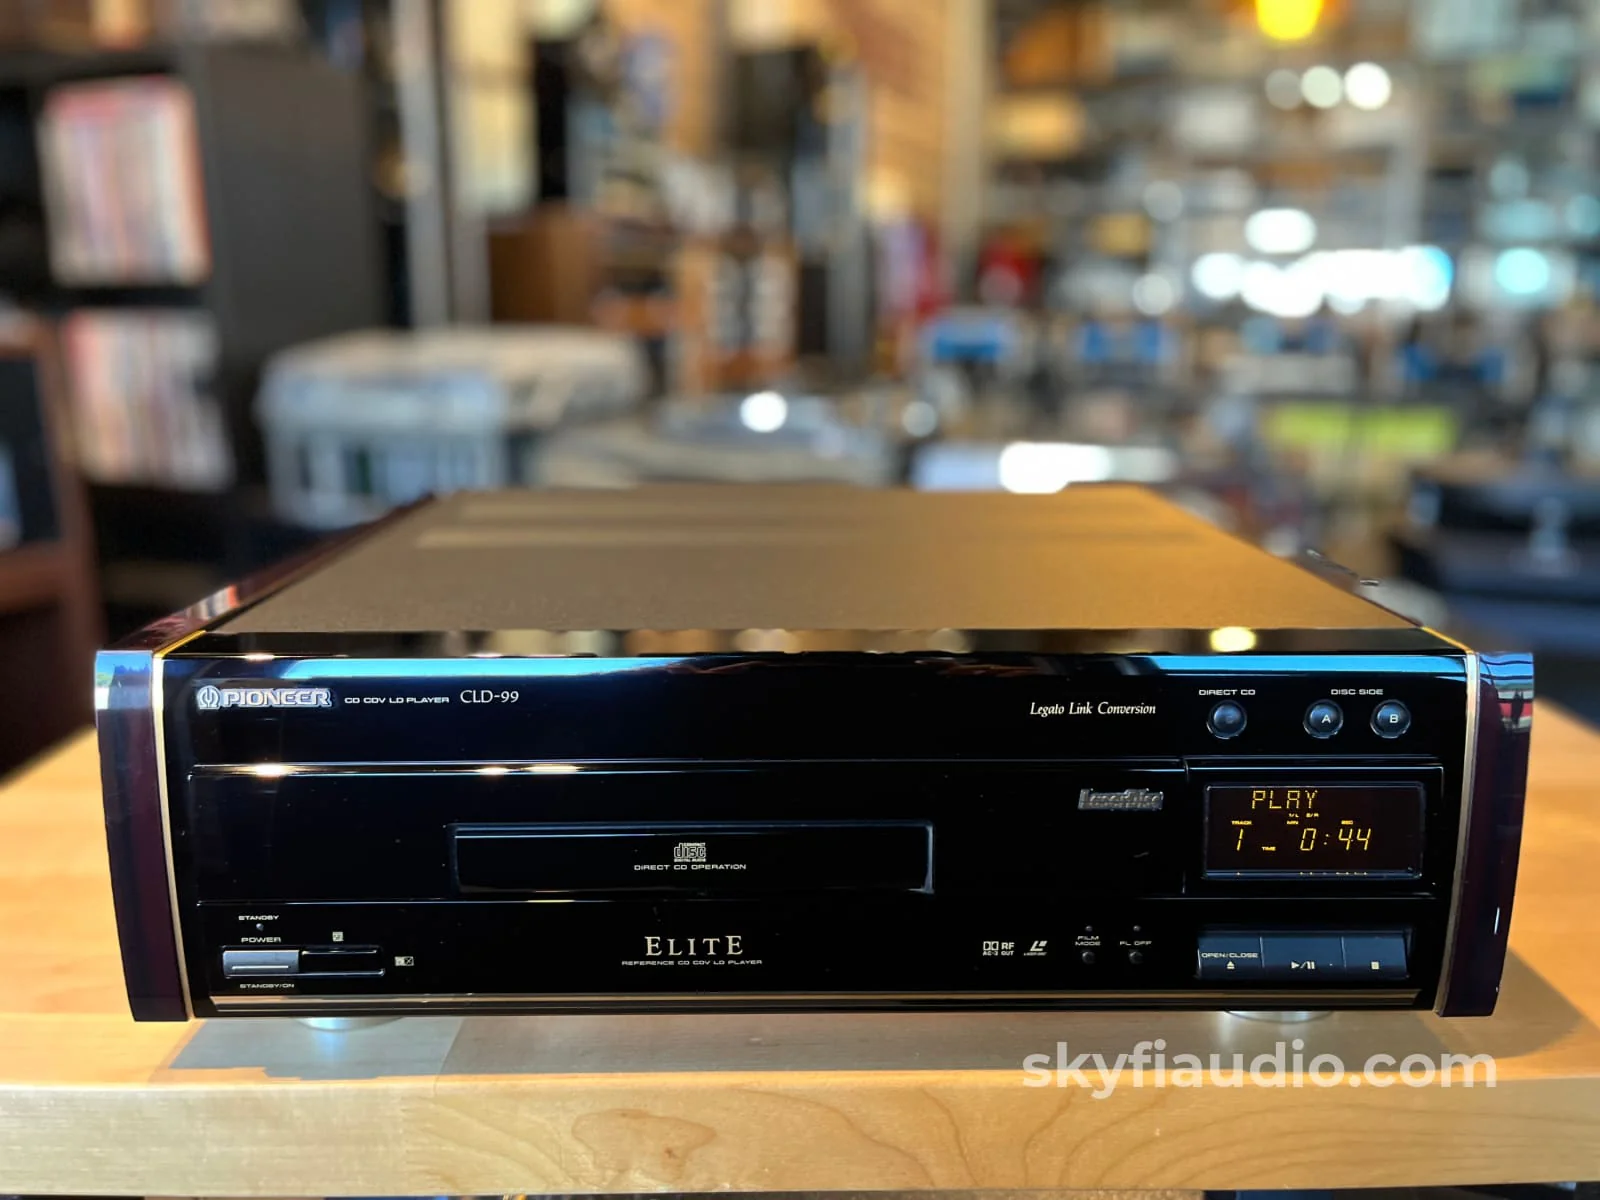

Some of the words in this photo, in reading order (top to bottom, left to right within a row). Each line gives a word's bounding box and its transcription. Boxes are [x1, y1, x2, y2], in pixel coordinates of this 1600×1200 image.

[223, 688, 332, 707] PIONEER
[459, 689, 520, 704] CLD-99
[1029, 701, 1065, 718] Legato
[1069, 701, 1093, 715] Link
[1097, 701, 1157, 715] Conversion
[1321, 714, 1332, 724] A
[1389, 714, 1399, 724] B
[1251, 790, 1318, 809] PLAY
[1236, 828, 1244, 851] 1
[1300, 828, 1371, 851] 0:44
[644, 935, 743, 956] ELITE
[1001, 942, 1015, 950] RF
